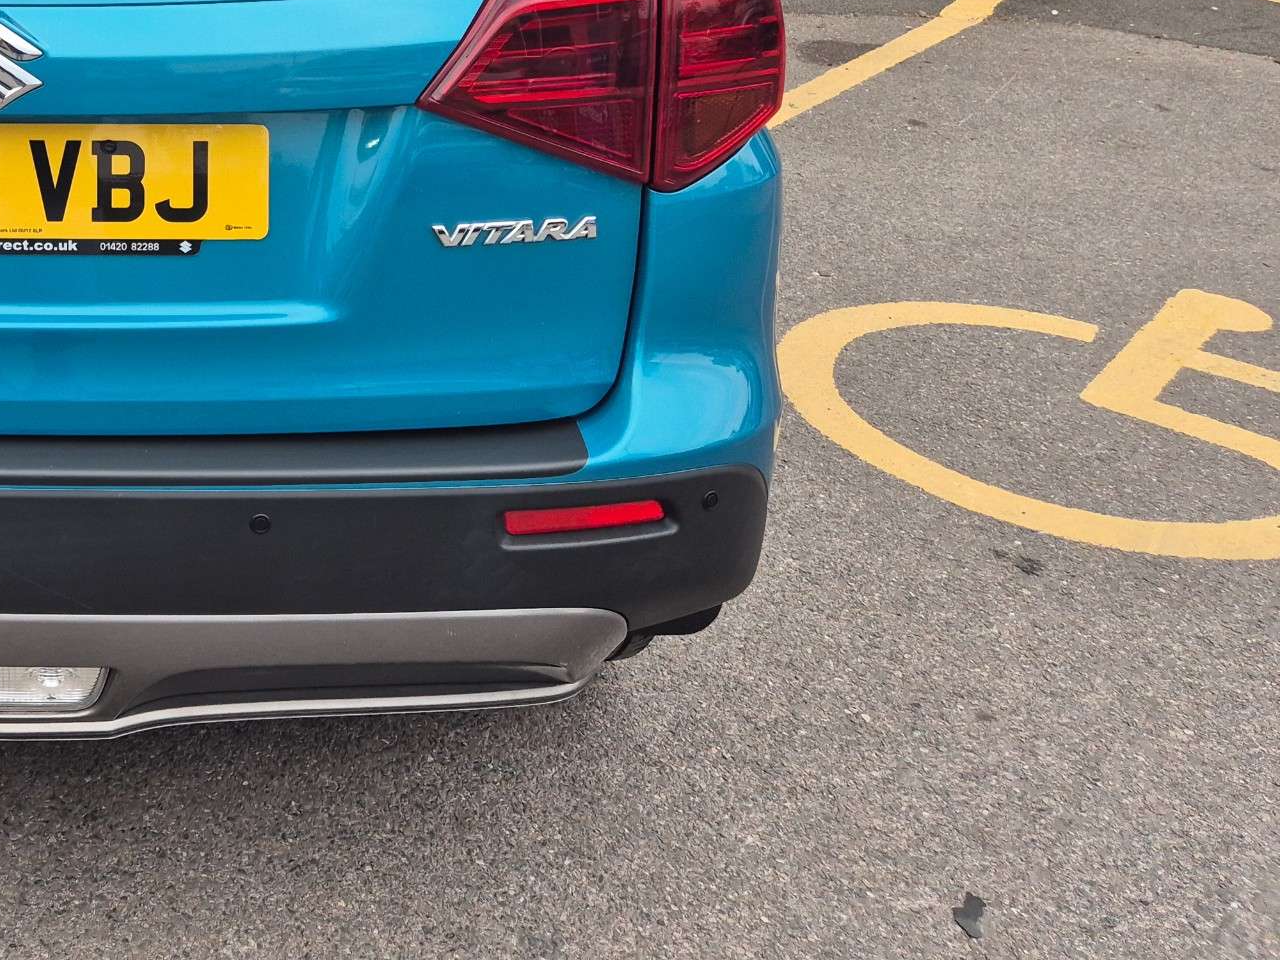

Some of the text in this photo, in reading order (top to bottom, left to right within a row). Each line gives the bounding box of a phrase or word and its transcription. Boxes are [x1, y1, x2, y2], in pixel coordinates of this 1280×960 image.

[29, 140, 209, 223] VBJ
[99, 242, 128, 251] 01420
[131, 242, 160, 251] 82288
[431, 215, 597, 247] VITARA
